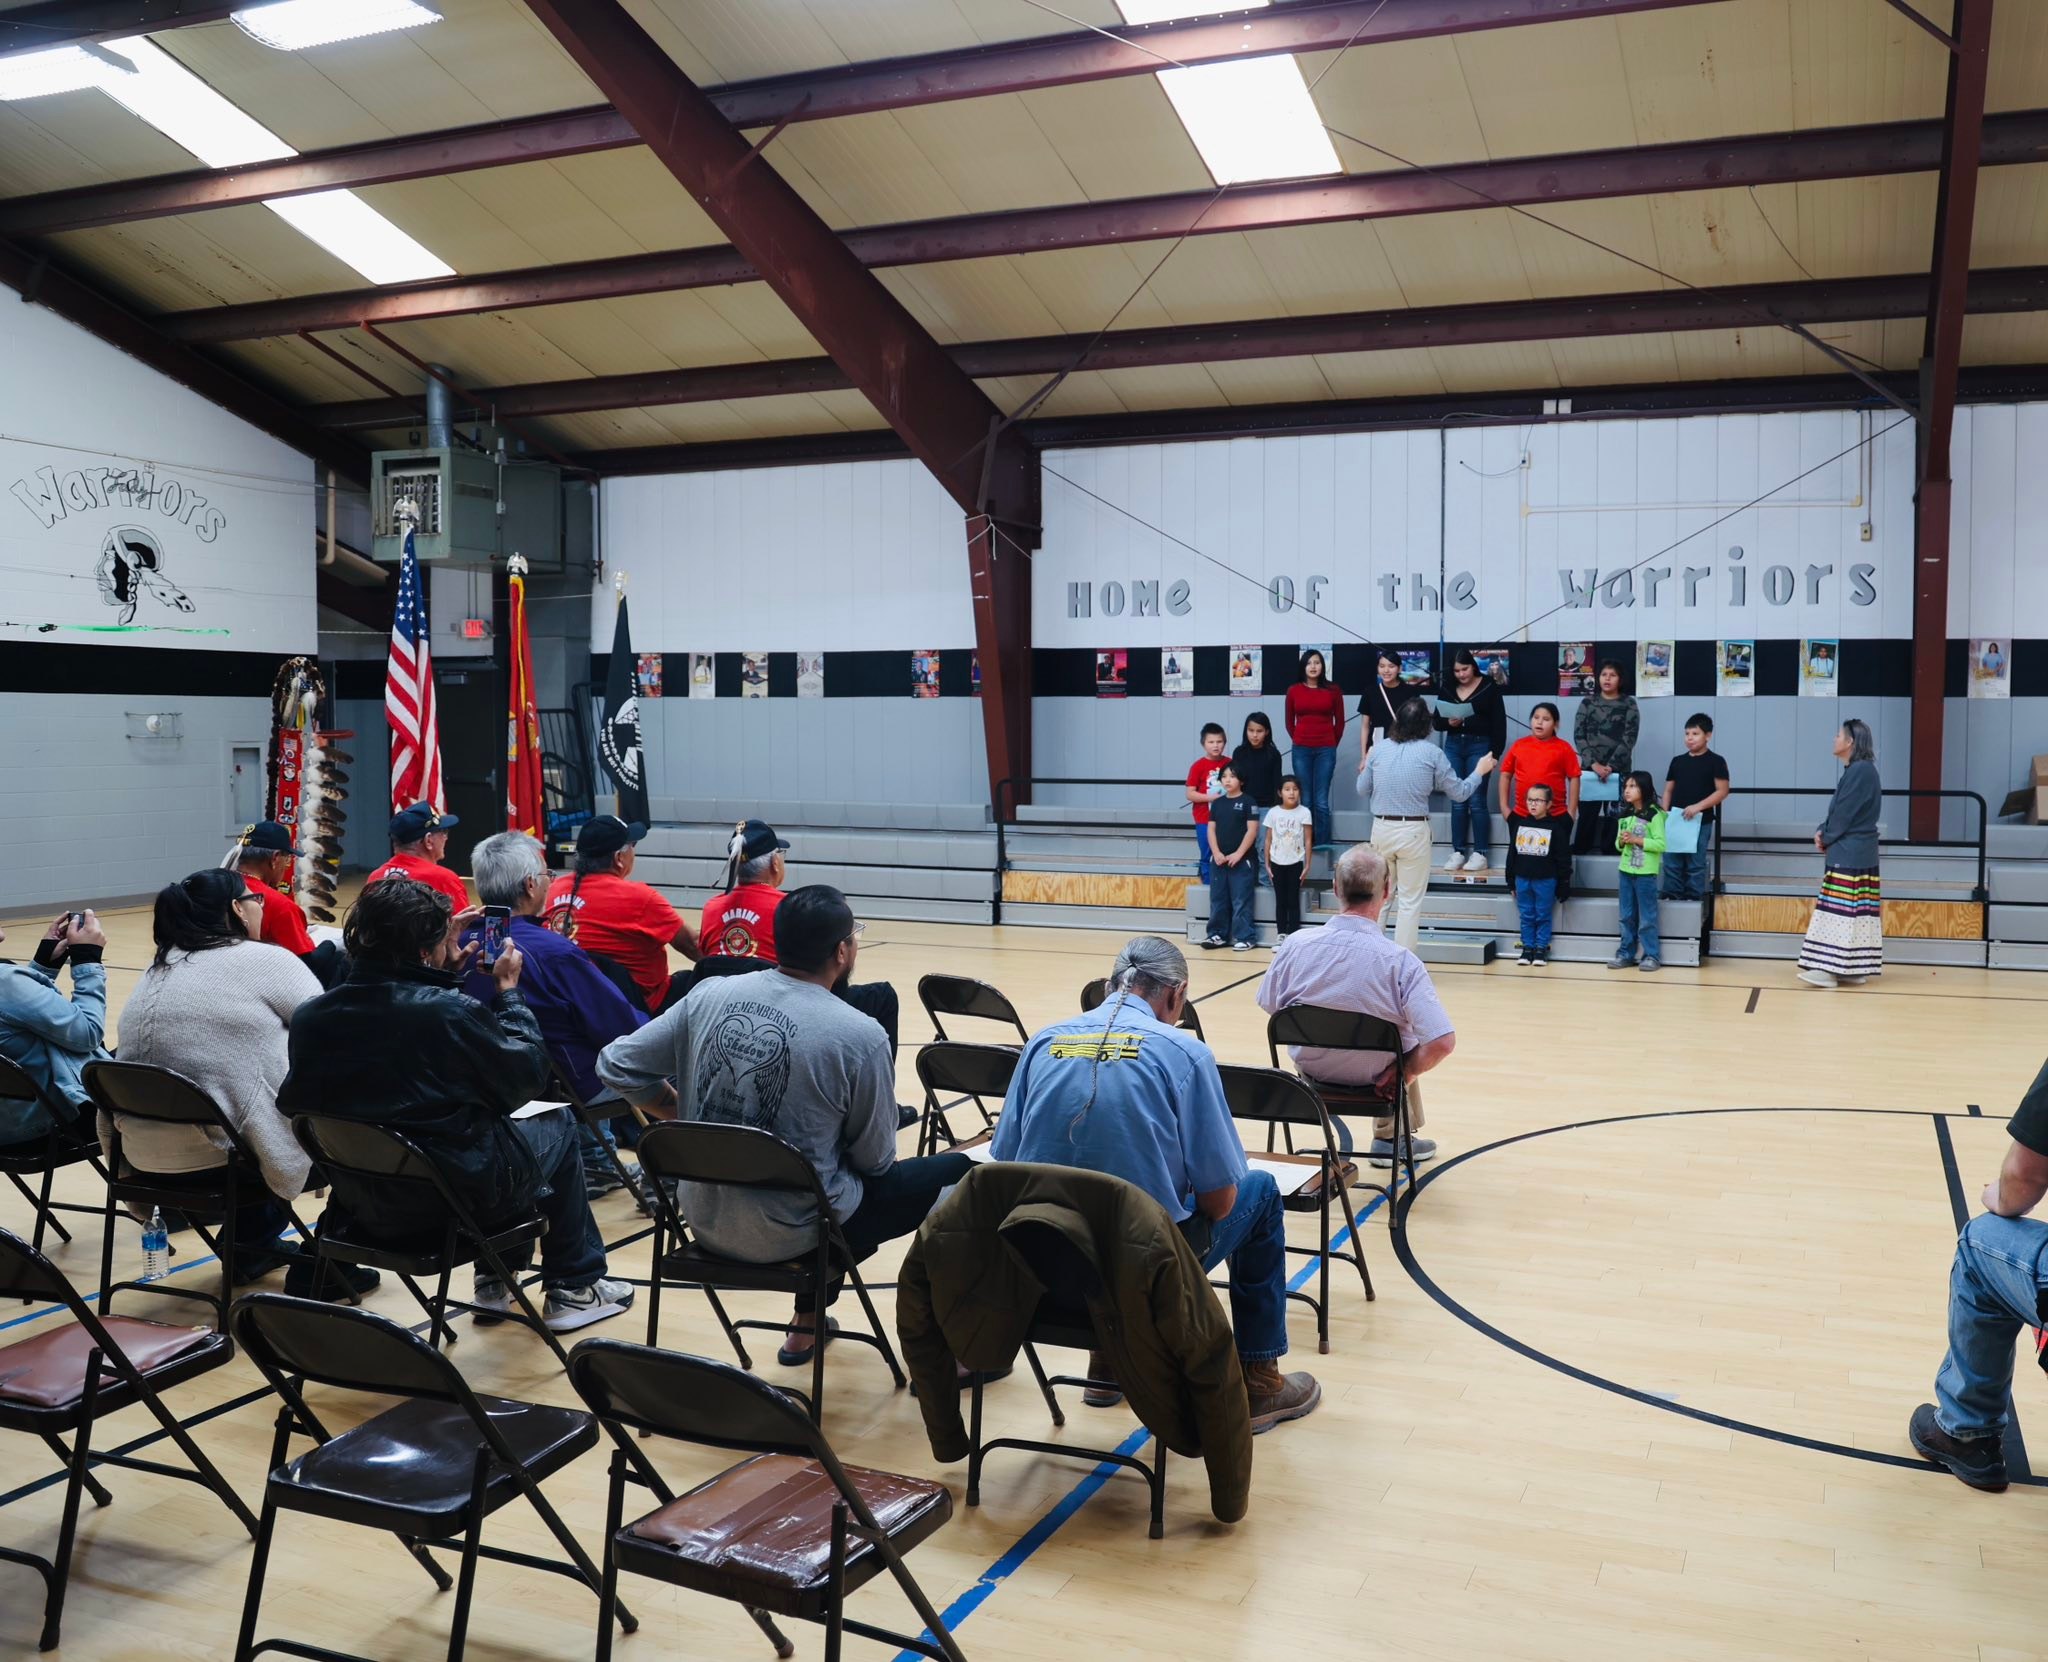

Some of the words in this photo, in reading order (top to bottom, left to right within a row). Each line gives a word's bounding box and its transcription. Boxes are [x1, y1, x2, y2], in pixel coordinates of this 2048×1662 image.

[9, 463, 226, 543] Warriors
[1377, 571, 1478, 612] the
[602, 743, 611, 756] ARE
[607, 756, 618, 768] NOT
[722, 907, 760, 925] MARINE
[723, 1001, 799, 1038] REMEMBERING
